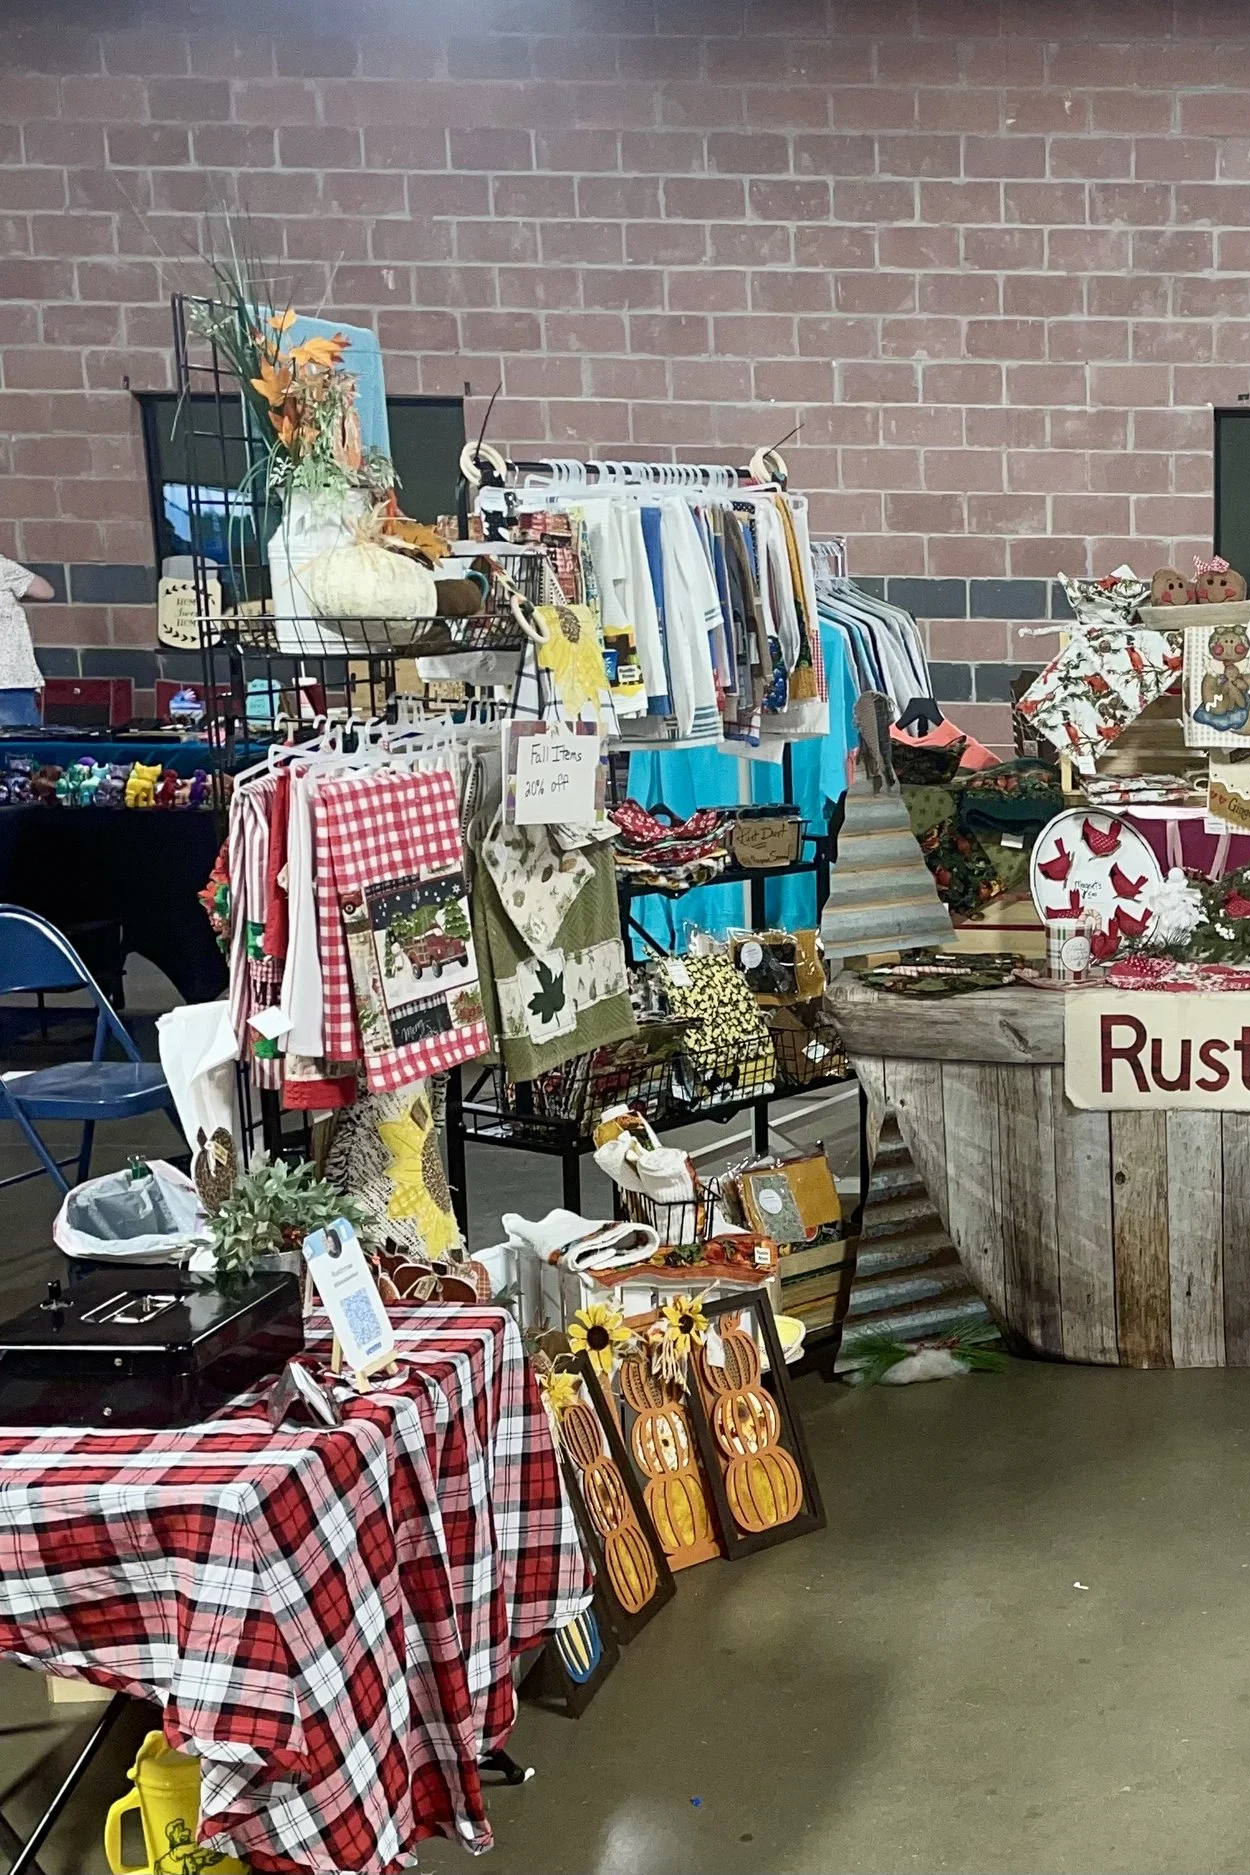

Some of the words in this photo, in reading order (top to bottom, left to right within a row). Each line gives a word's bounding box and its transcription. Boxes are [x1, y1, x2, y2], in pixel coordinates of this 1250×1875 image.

[530, 743, 549, 765] Fall
[551, 744, 582, 762] Items
[524, 779, 545, 798] 20%
[550, 773, 570, 793] off
